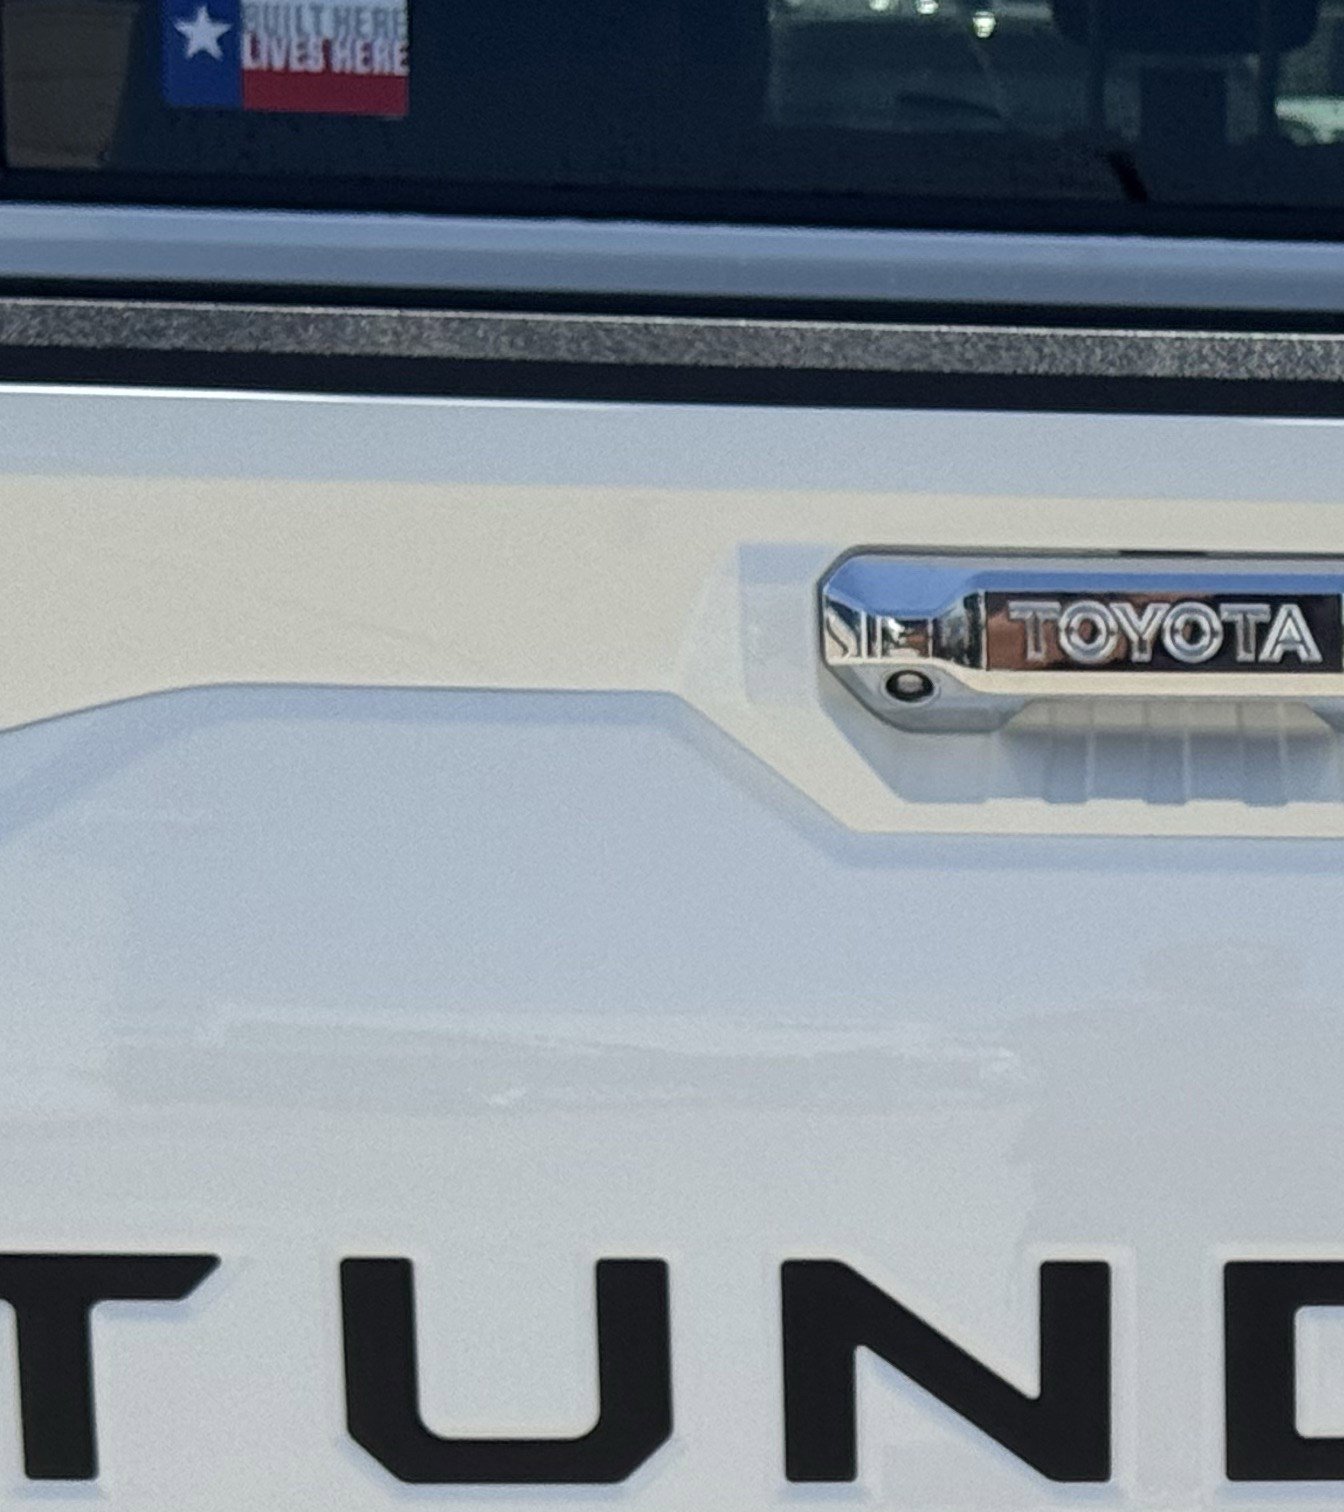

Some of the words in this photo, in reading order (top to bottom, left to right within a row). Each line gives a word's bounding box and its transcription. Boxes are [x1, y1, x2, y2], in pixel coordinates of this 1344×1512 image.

[241, 32, 324, 72] LIVES
[330, 36, 409, 76] HERE
[1006, 599, 1324, 664] TOYOTA
